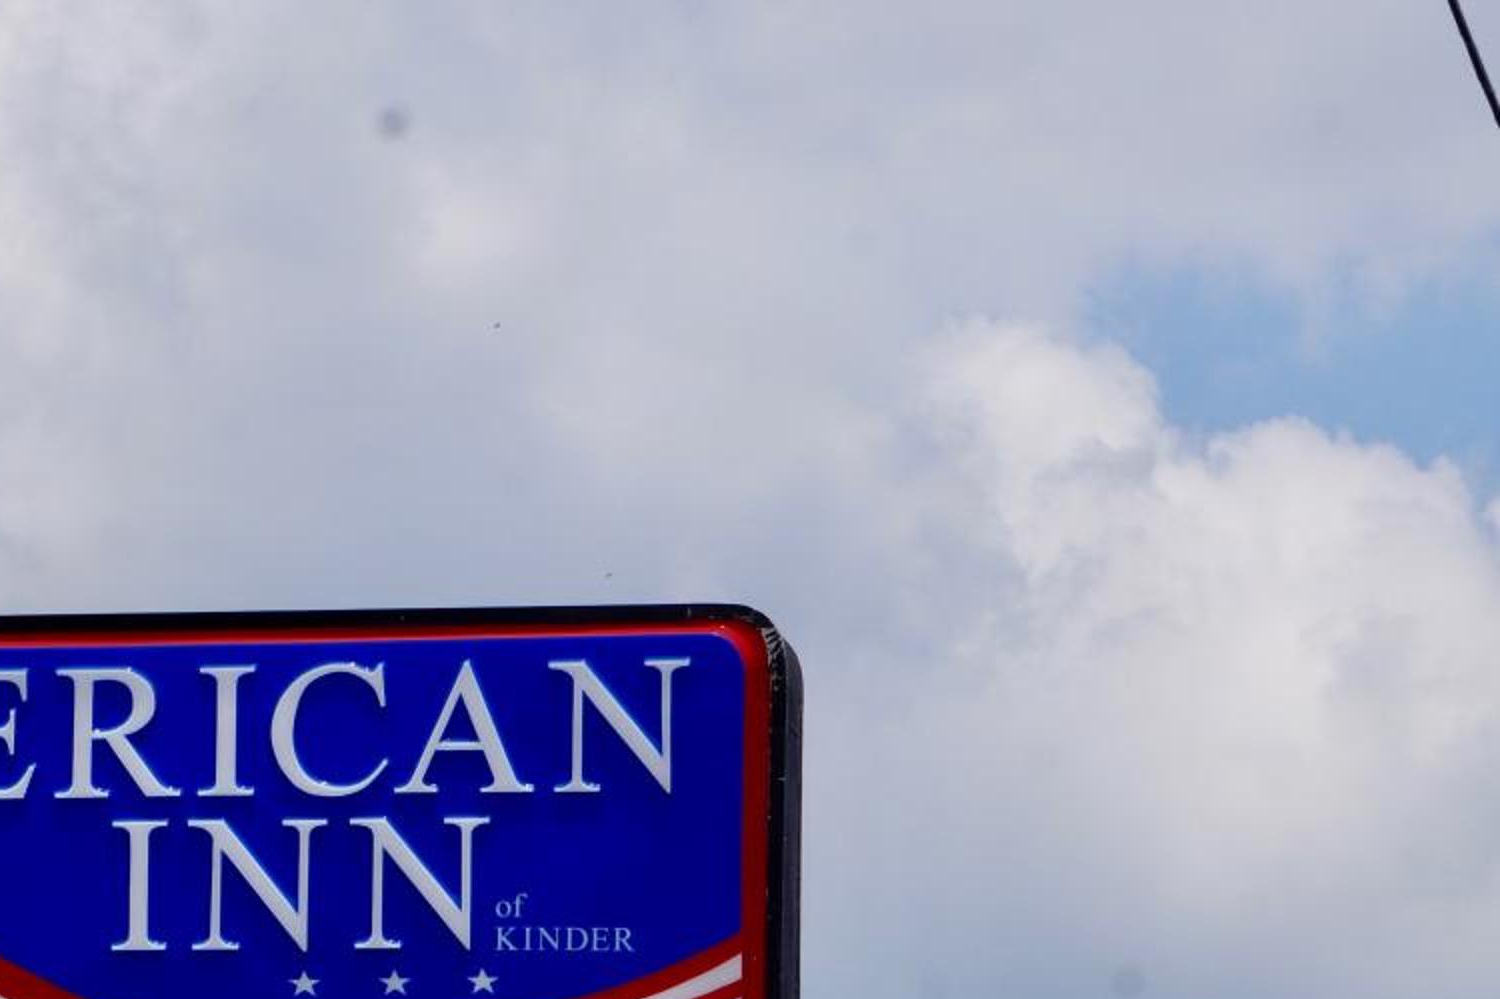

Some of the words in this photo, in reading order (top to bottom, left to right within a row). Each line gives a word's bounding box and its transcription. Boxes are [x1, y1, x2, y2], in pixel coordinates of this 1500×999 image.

[110, 814, 491, 953] INN
[495, 893, 528, 918] of
[496, 926, 634, 952] KINDER
